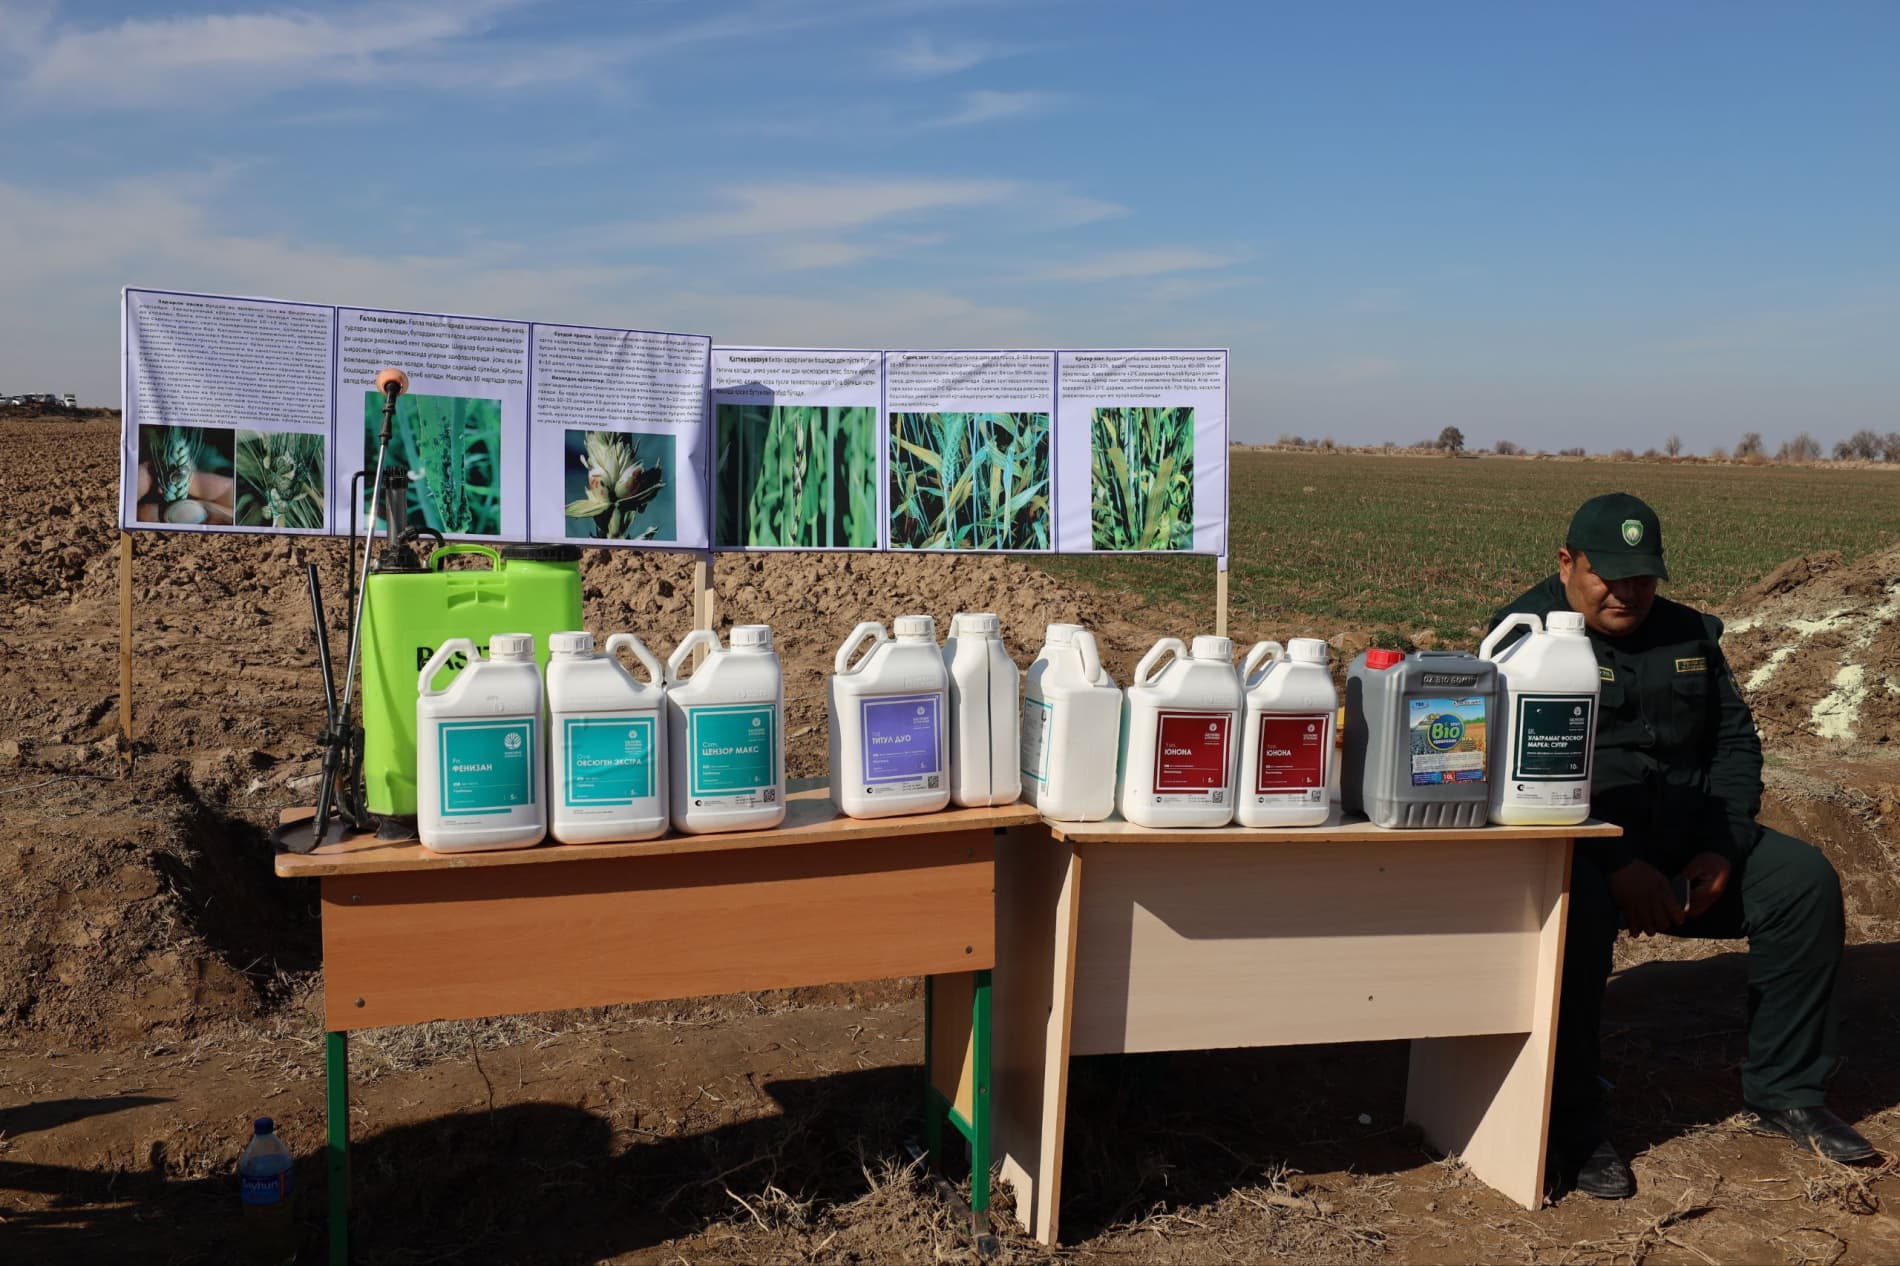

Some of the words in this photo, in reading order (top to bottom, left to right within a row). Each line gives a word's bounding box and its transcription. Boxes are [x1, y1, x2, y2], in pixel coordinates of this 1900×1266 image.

[871, 736, 894, 745] ТИТУЛ
[894, 734, 912, 744] ДУО
[702, 747, 734, 757] ЦЕНЗОР
[735, 745, 759, 754] МАКС
[1164, 748, 1193, 756] ЮНОНА
[1266, 749, 1292, 757] ЮНОНА
[452, 763, 493, 773] ФЕНИЗАН
[576, 758, 612, 768] ОВСЮГЕН
[614, 758, 642, 767] ЭКСТРА
